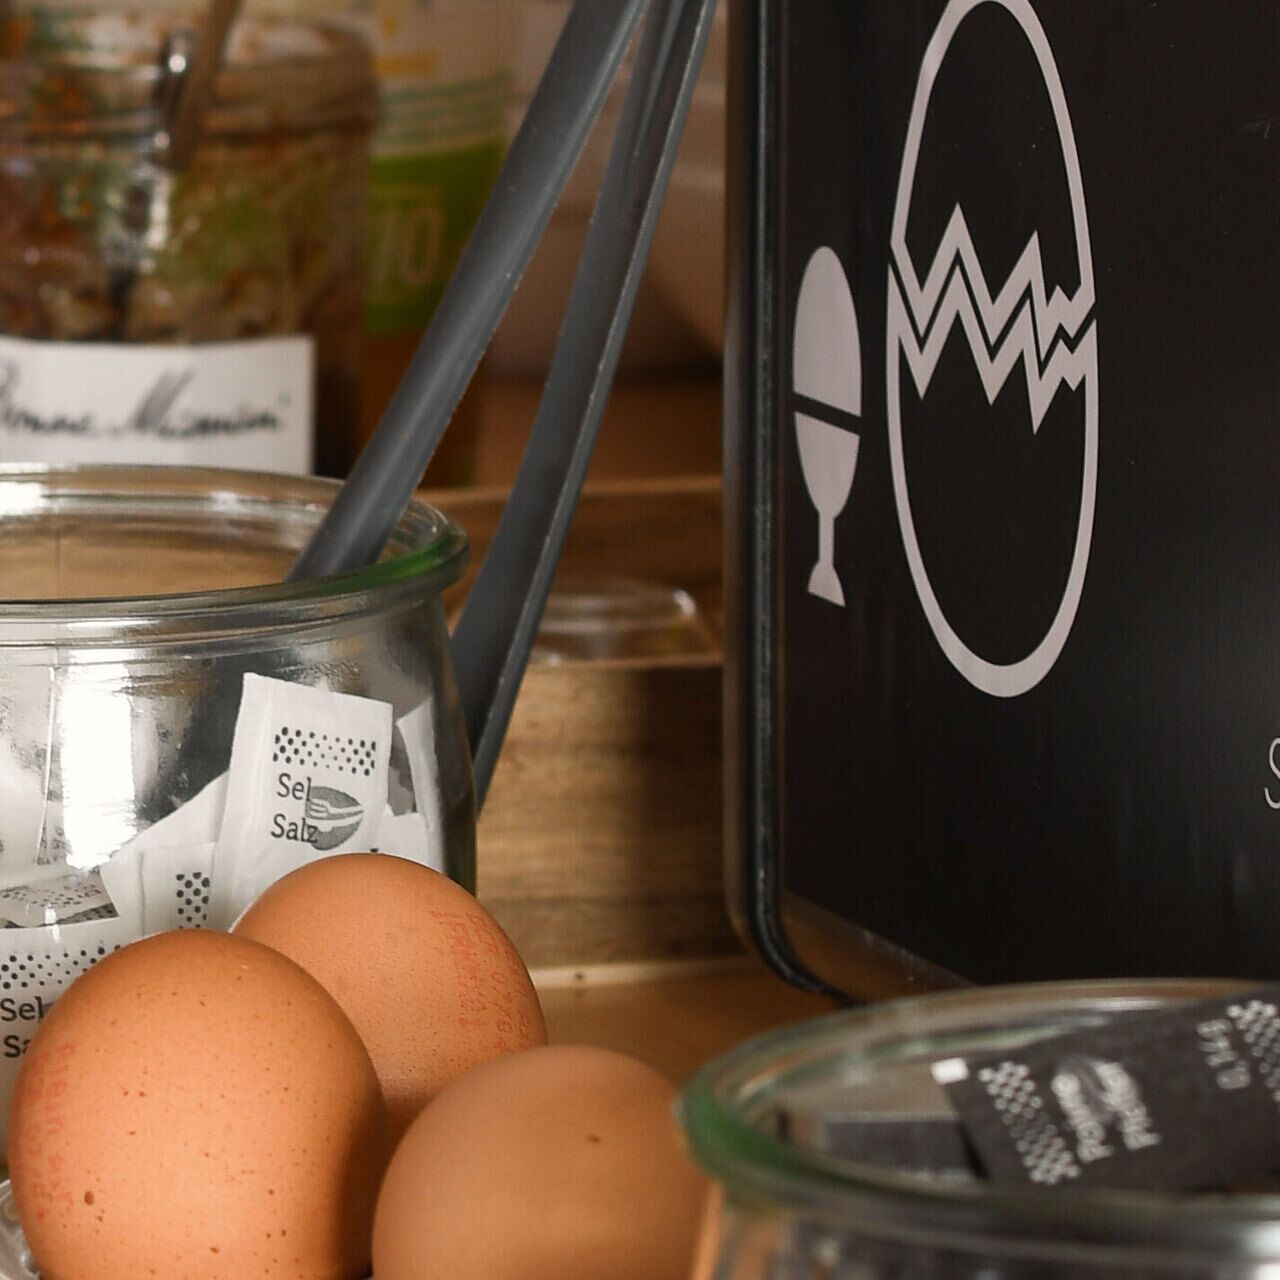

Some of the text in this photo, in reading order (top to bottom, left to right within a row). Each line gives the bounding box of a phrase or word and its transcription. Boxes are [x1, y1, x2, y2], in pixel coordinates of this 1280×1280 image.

[276, 772, 312, 802] Sel
[270, 813, 319, 844] Salz
[0, 995, 45, 1023] Sel
